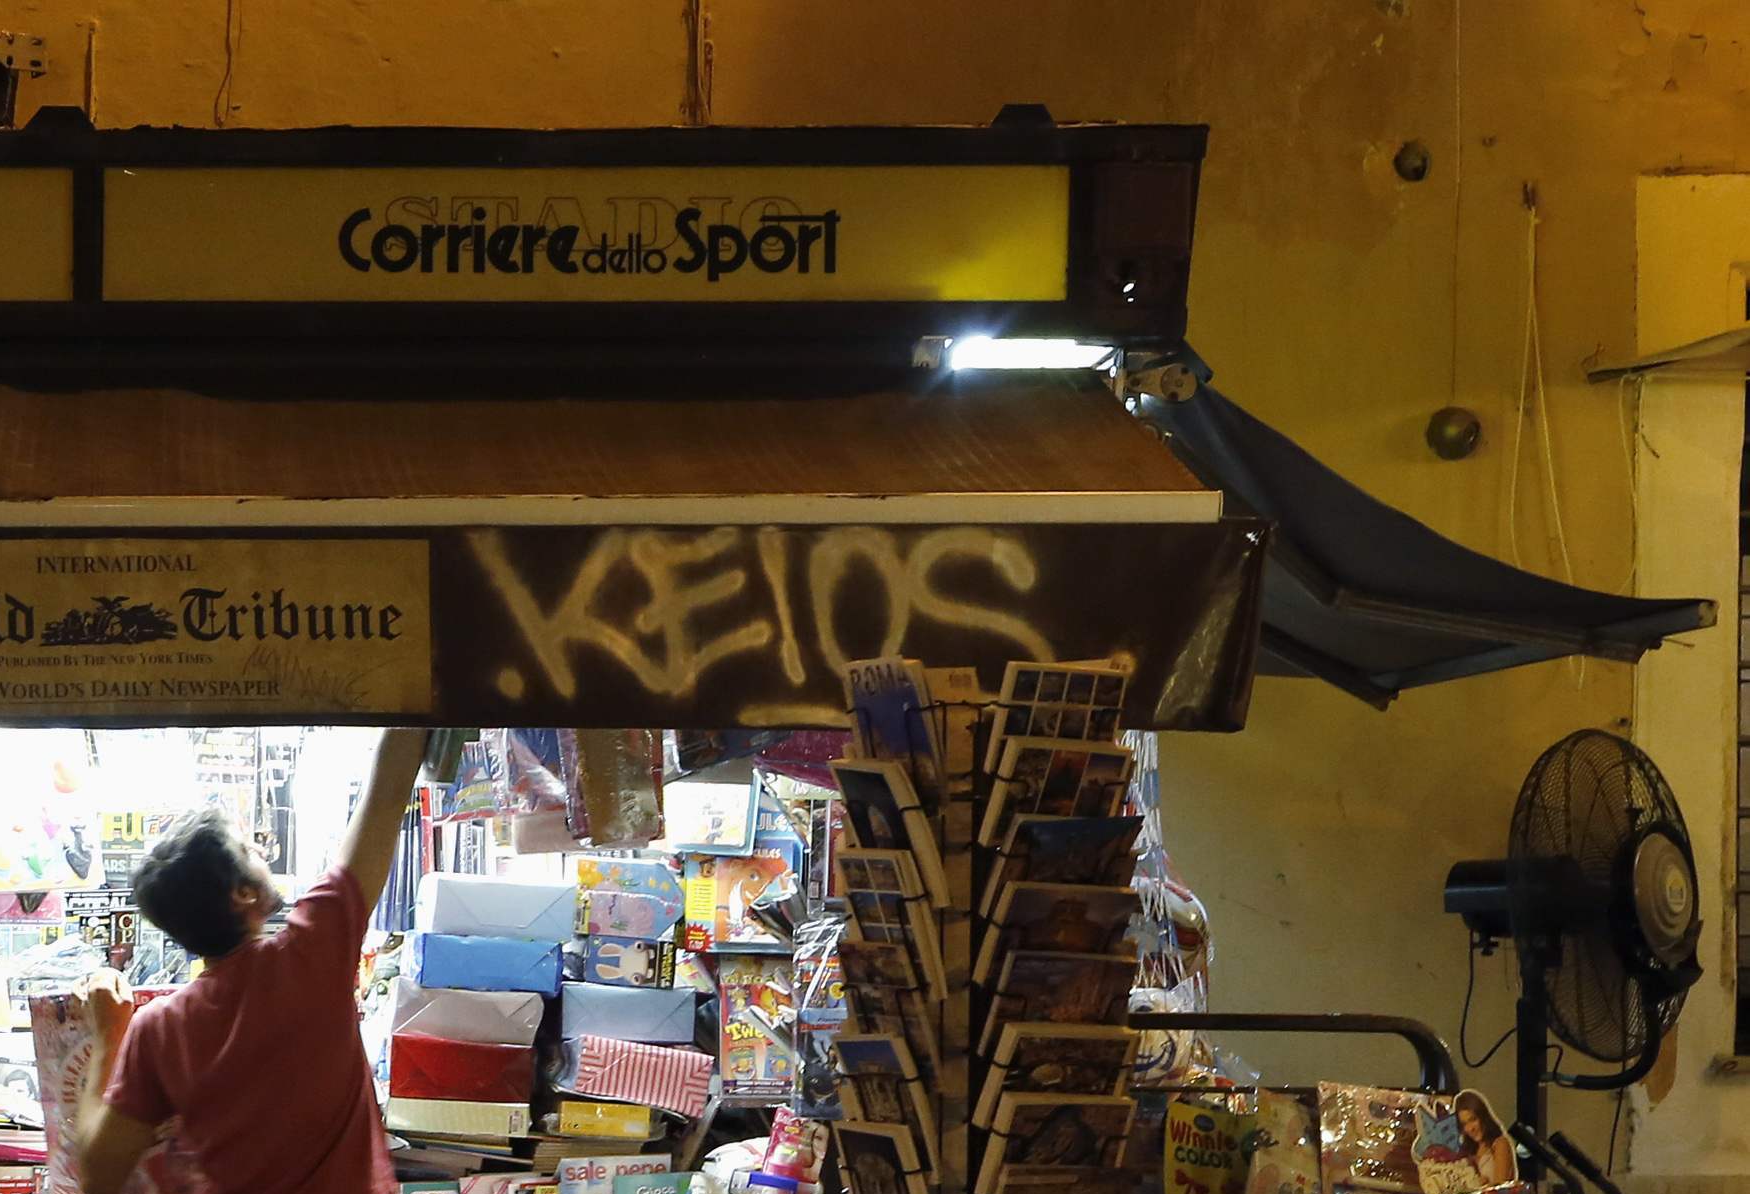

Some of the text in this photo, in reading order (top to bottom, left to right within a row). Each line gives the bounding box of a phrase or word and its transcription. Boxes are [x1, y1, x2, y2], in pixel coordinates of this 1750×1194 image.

[338, 207, 841, 282] Corriere dello Sport
[36, 554, 197, 574] INTERNATIONAL
[179, 587, 404, 642] Tribune
[90, 680, 153, 699] DAILY
[157, 678, 281, 698] NEWSPAPER
[1169, 1117, 1238, 1152] Winnie
[565, 1162, 607, 1182] sale
